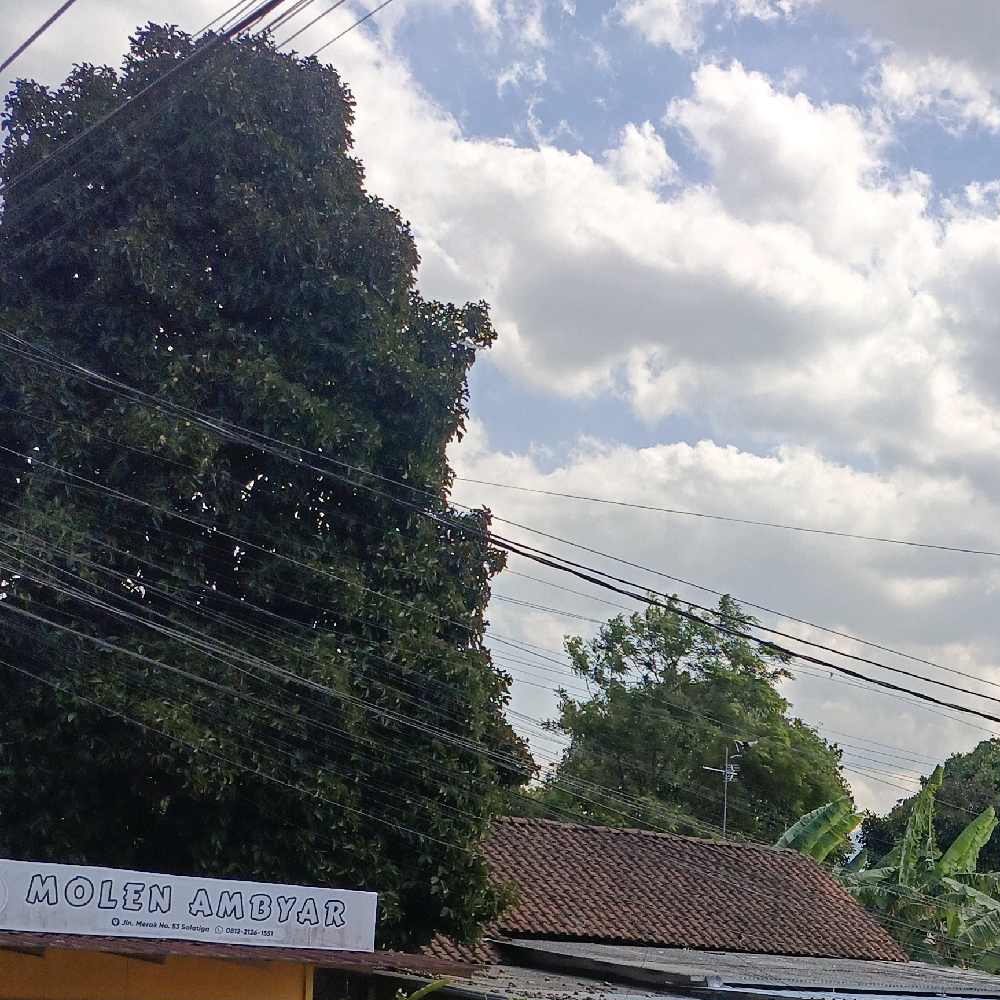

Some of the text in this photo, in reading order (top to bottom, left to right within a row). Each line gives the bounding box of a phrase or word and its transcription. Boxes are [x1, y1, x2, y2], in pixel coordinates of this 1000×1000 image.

[26, 874, 347, 929] MOLEN AMBYAR
[135, 920, 158, 928] Merak
[181, 924, 210, 933] Salatiga
